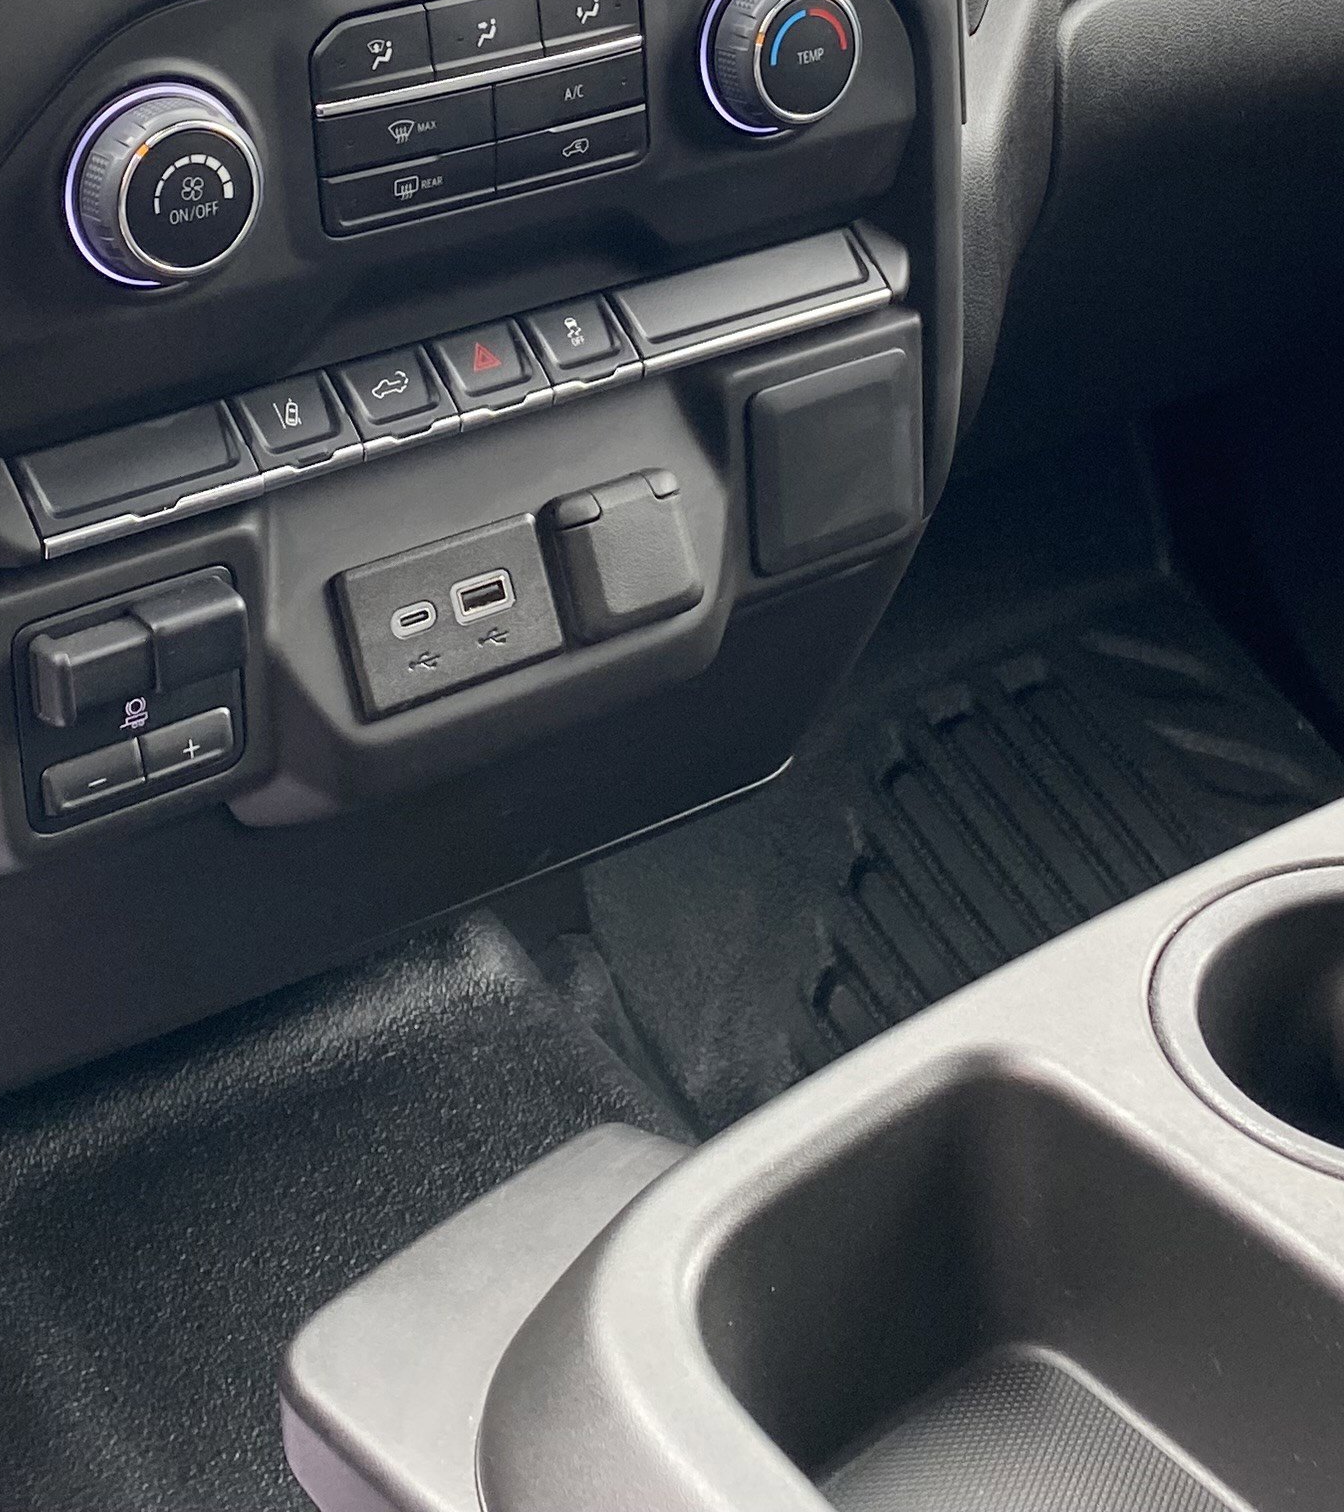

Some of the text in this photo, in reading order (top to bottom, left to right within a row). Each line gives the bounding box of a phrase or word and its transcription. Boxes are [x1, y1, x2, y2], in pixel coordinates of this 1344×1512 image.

[797, 48, 824, 65] TEMP
[564, 85, 584, 102] A/C
[417, 121, 436, 133] MAX
[421, 176, 443, 189] REAR
[170, 201, 219, 225] ON/OFF
